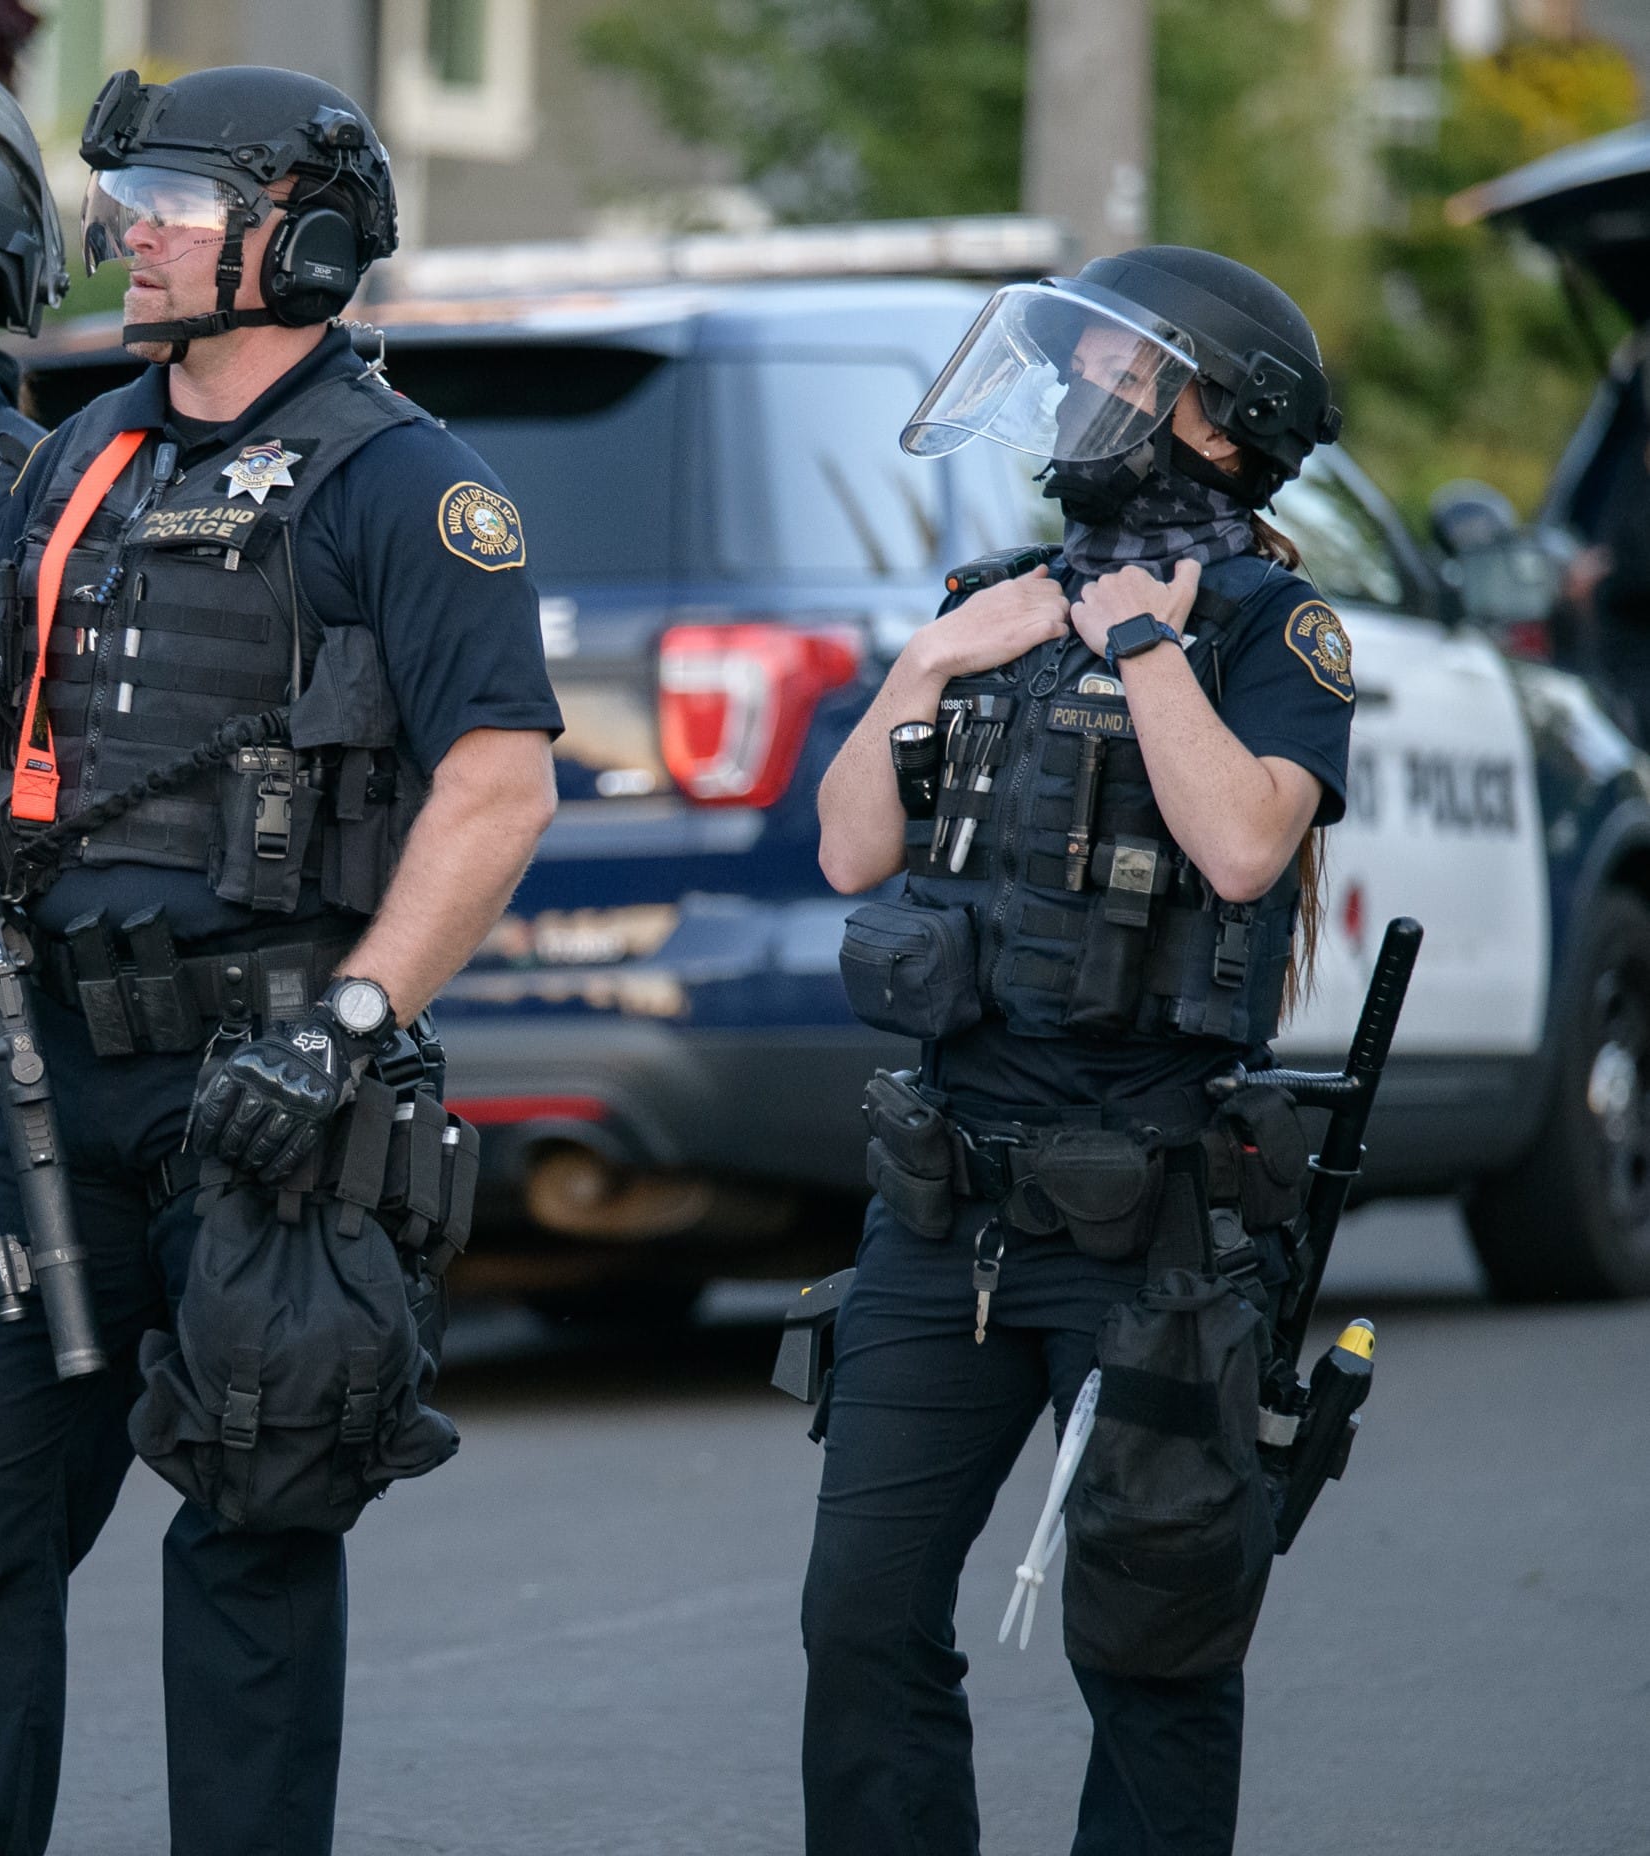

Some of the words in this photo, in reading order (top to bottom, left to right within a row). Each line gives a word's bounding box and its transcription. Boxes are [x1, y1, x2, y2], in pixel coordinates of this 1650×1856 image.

[145, 507, 255, 526] PORTLAND
[448, 491, 471, 535] BUREAU
[469, 488, 484, 501] OF
[483, 491, 517, 526] POLICE
[142, 521, 238, 539] POLICE
[471, 533, 519, 556] PORTLAND
[1296, 609, 1330, 638] BUREAU
[1053, 707, 1123, 732] PORTLAND
